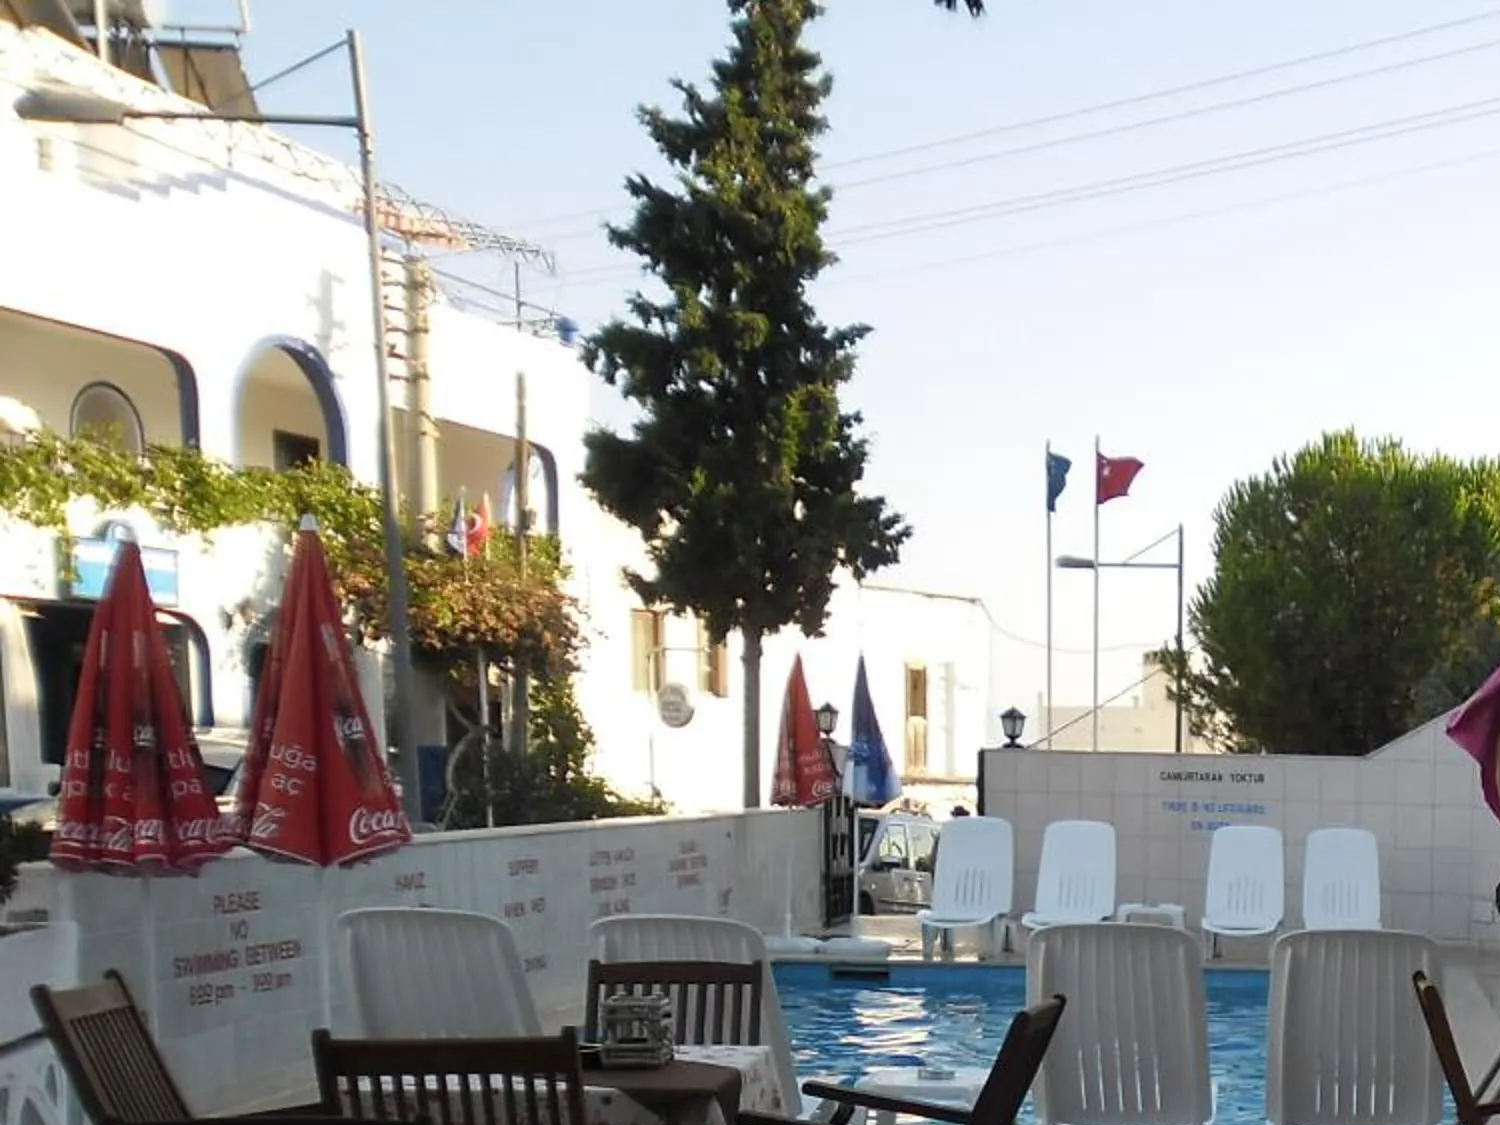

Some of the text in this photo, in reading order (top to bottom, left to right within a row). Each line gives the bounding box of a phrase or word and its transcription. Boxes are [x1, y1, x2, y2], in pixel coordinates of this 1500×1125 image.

[212, 890, 261, 914] PLEASE
[230, 919, 250, 940] NO
[173, 940, 302, 978] SWIMMING BETWEEN
